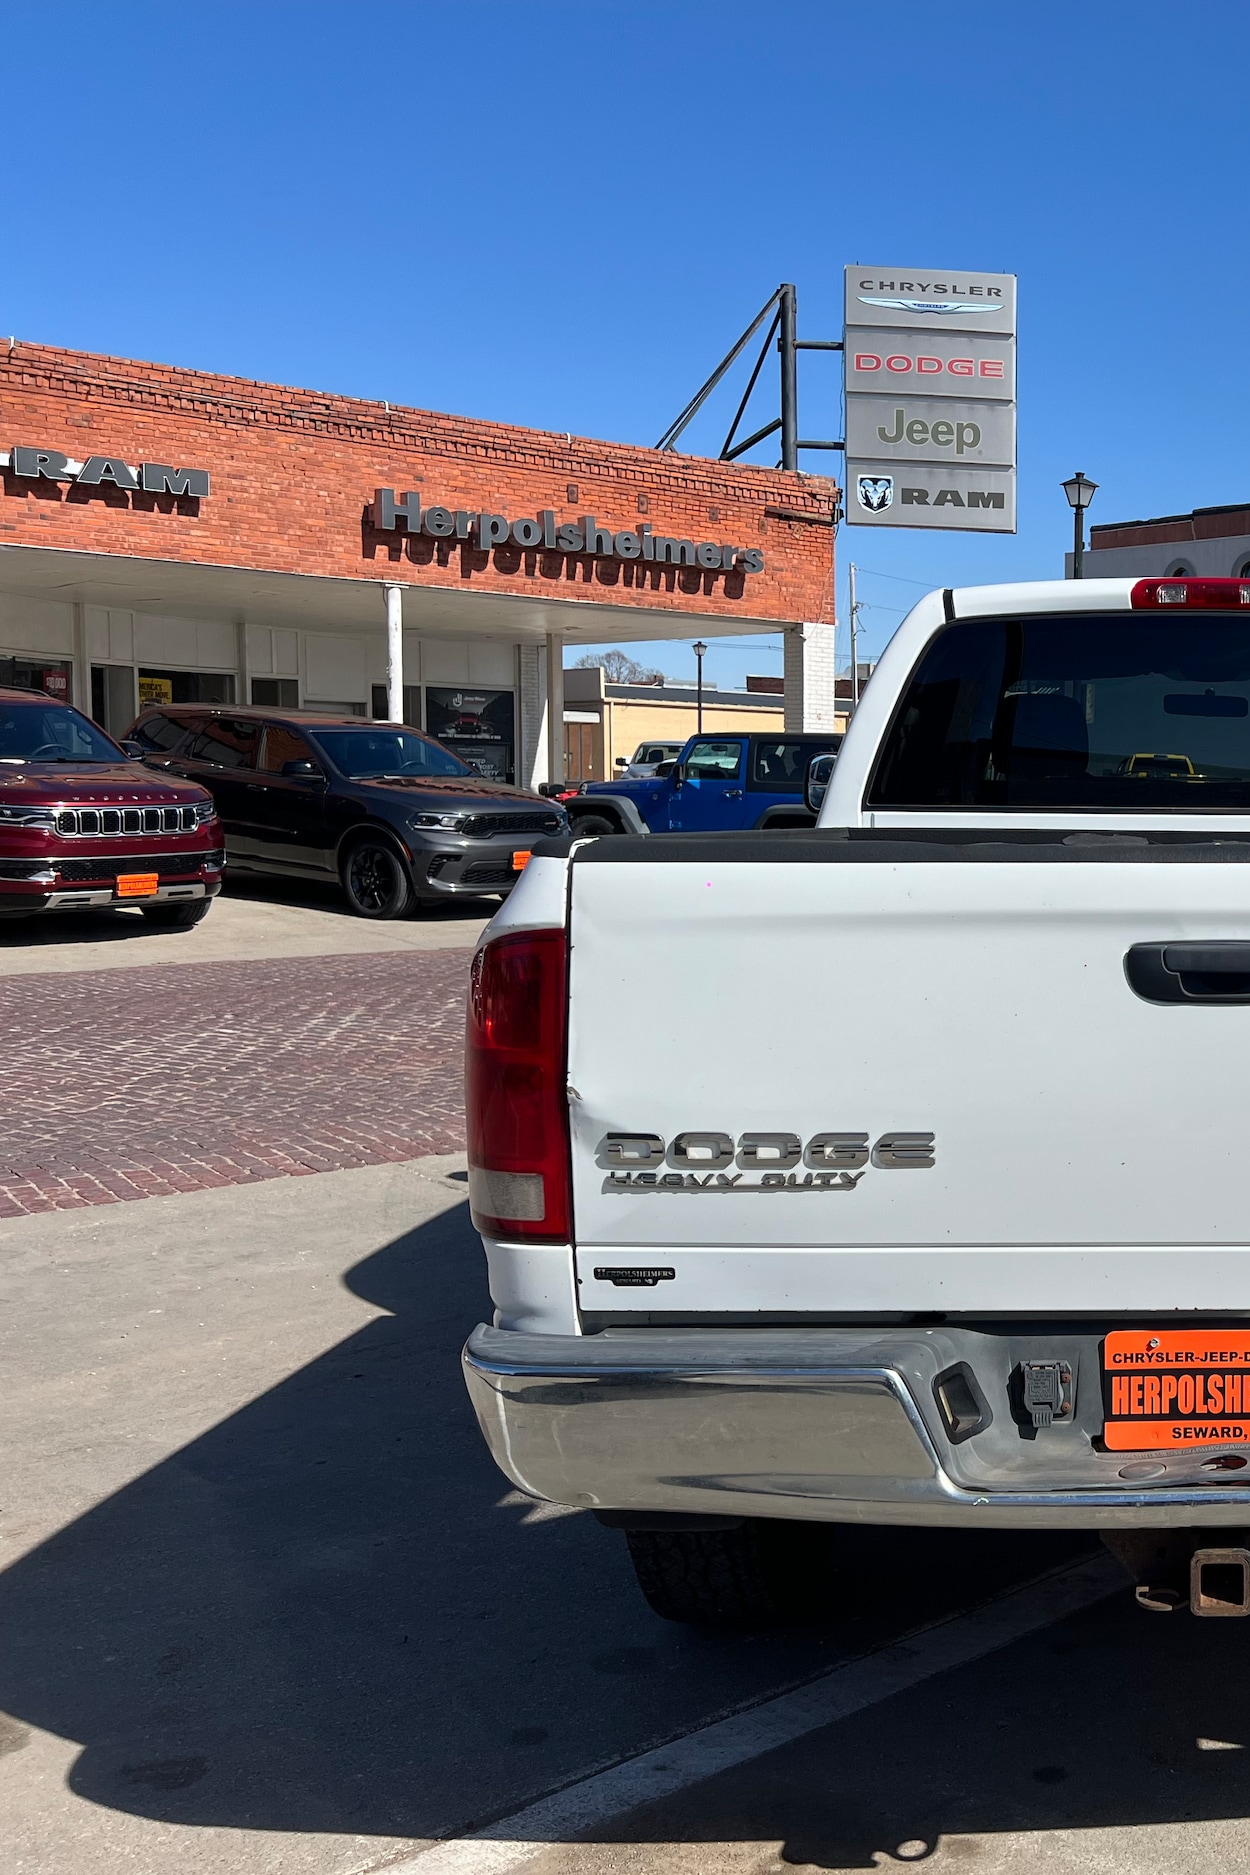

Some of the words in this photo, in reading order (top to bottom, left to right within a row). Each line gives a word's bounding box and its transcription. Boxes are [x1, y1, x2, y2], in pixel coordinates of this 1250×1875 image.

[858, 280, 1003, 297] CHRYSLER
[854, 353, 1005, 379] DODGE
[877, 408, 982, 455] Jeep
[10, 446, 211, 497] RAM
[900, 487, 1005, 510] RAM
[375, 488, 765, 573] Herpolsheimers
[596, 1131, 936, 1170] DODGE
[605, 1171, 745, 1189] HEAVY
[759, 1171, 866, 1189] DUTY
[1171, 1426, 1249, 1440] SEWARD,
